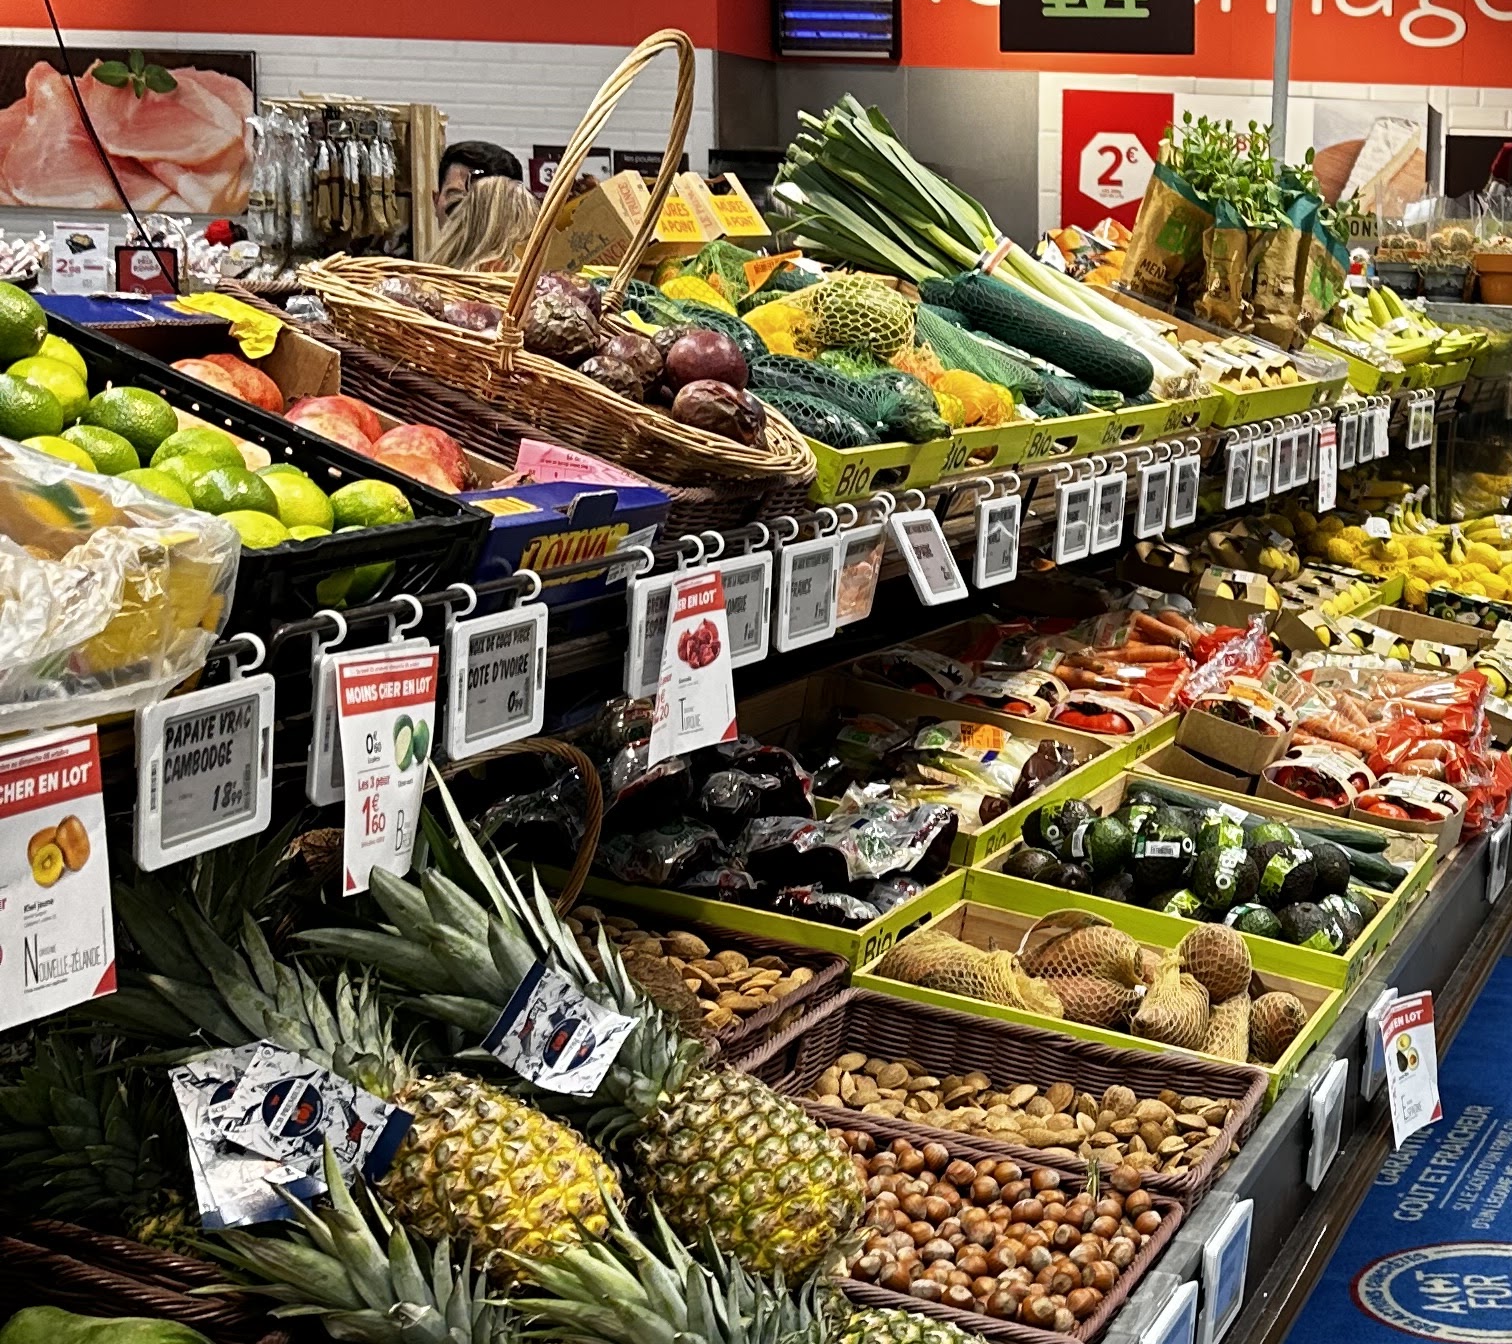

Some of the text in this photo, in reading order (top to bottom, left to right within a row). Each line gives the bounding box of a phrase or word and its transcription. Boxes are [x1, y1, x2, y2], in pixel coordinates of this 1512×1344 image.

[1027, 429, 1051, 458] Bio
[836, 458, 870, 497] Bio
[468, 653, 530, 691] COTE D'IVOIRE
[345, 684, 378, 704] MOINS
[379, 681, 401, 700] CHER
[402, 679, 416, 696] EN
[165, 704, 251, 753] PAPAYE VRAC
[164, 739, 234, 785] CAMBODGE
[38, 771, 58, 795] EN
[357, 777, 370, 793] Les
[862, 927, 893, 967] Bio
[1393, 1104, 1495, 1222] GOÛT ET FRAÎCHEUR
